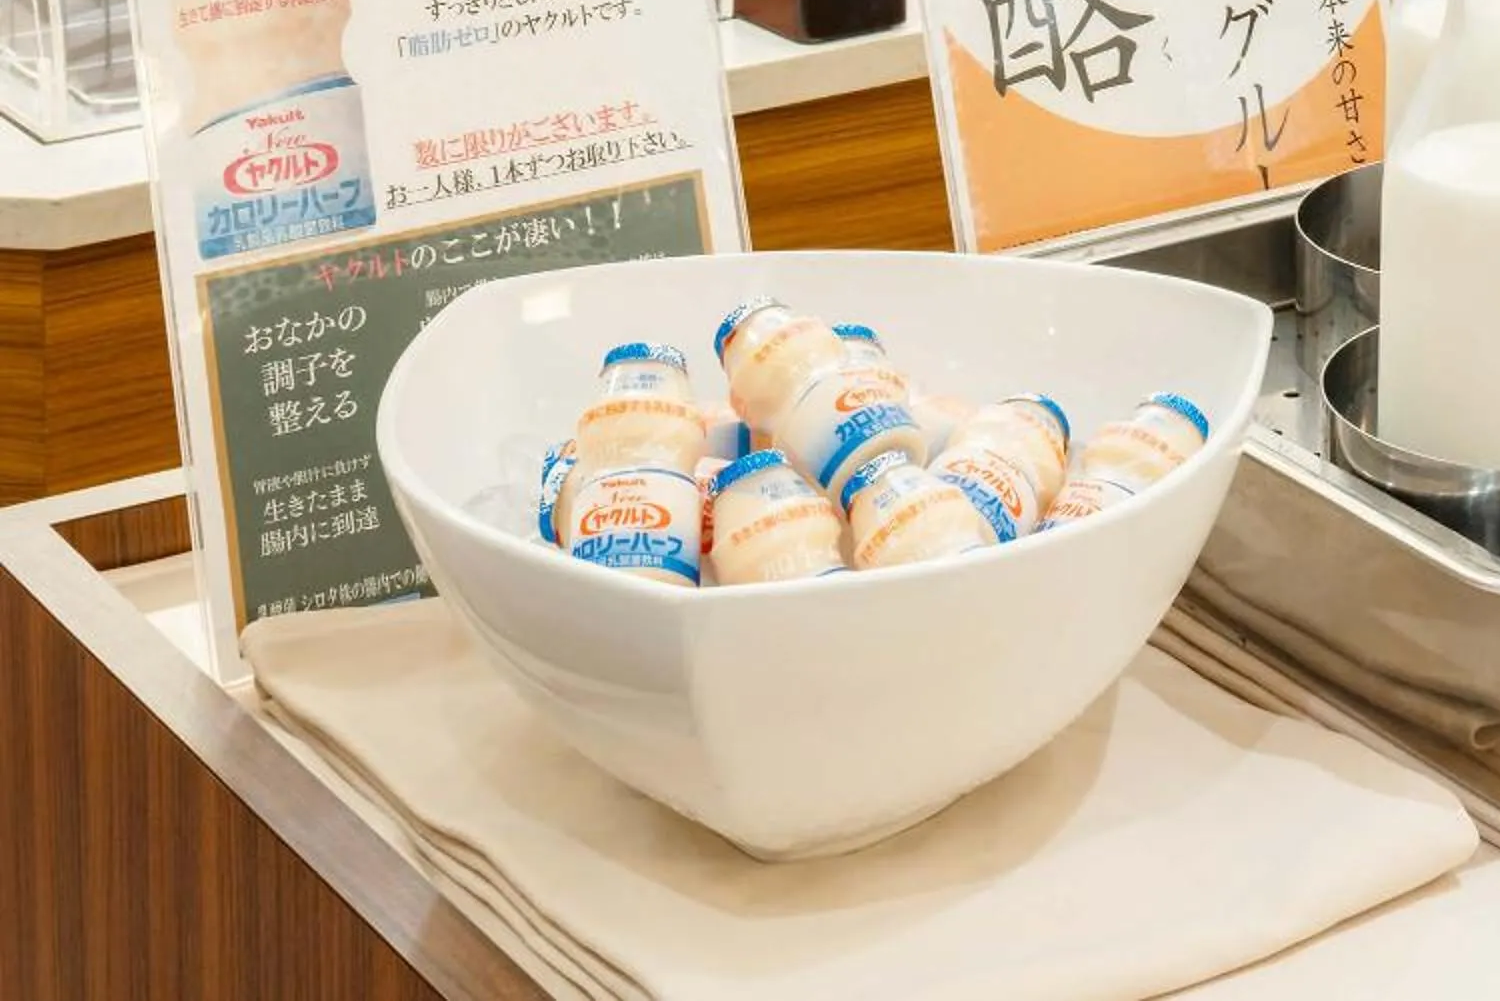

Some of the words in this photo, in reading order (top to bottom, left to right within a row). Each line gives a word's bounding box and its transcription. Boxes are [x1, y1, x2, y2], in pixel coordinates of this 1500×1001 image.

[414, 100, 650, 168] 数に限りがございます。
[208, 178, 362, 234] カロリーハーフ
[244, 304, 367, 355] おなかの
[259, 346, 355, 398] 調子を
[267, 389, 360, 437] 整える
[263, 478, 369, 525] 生きたまま
[259, 506, 381, 558] 腸内に到達
